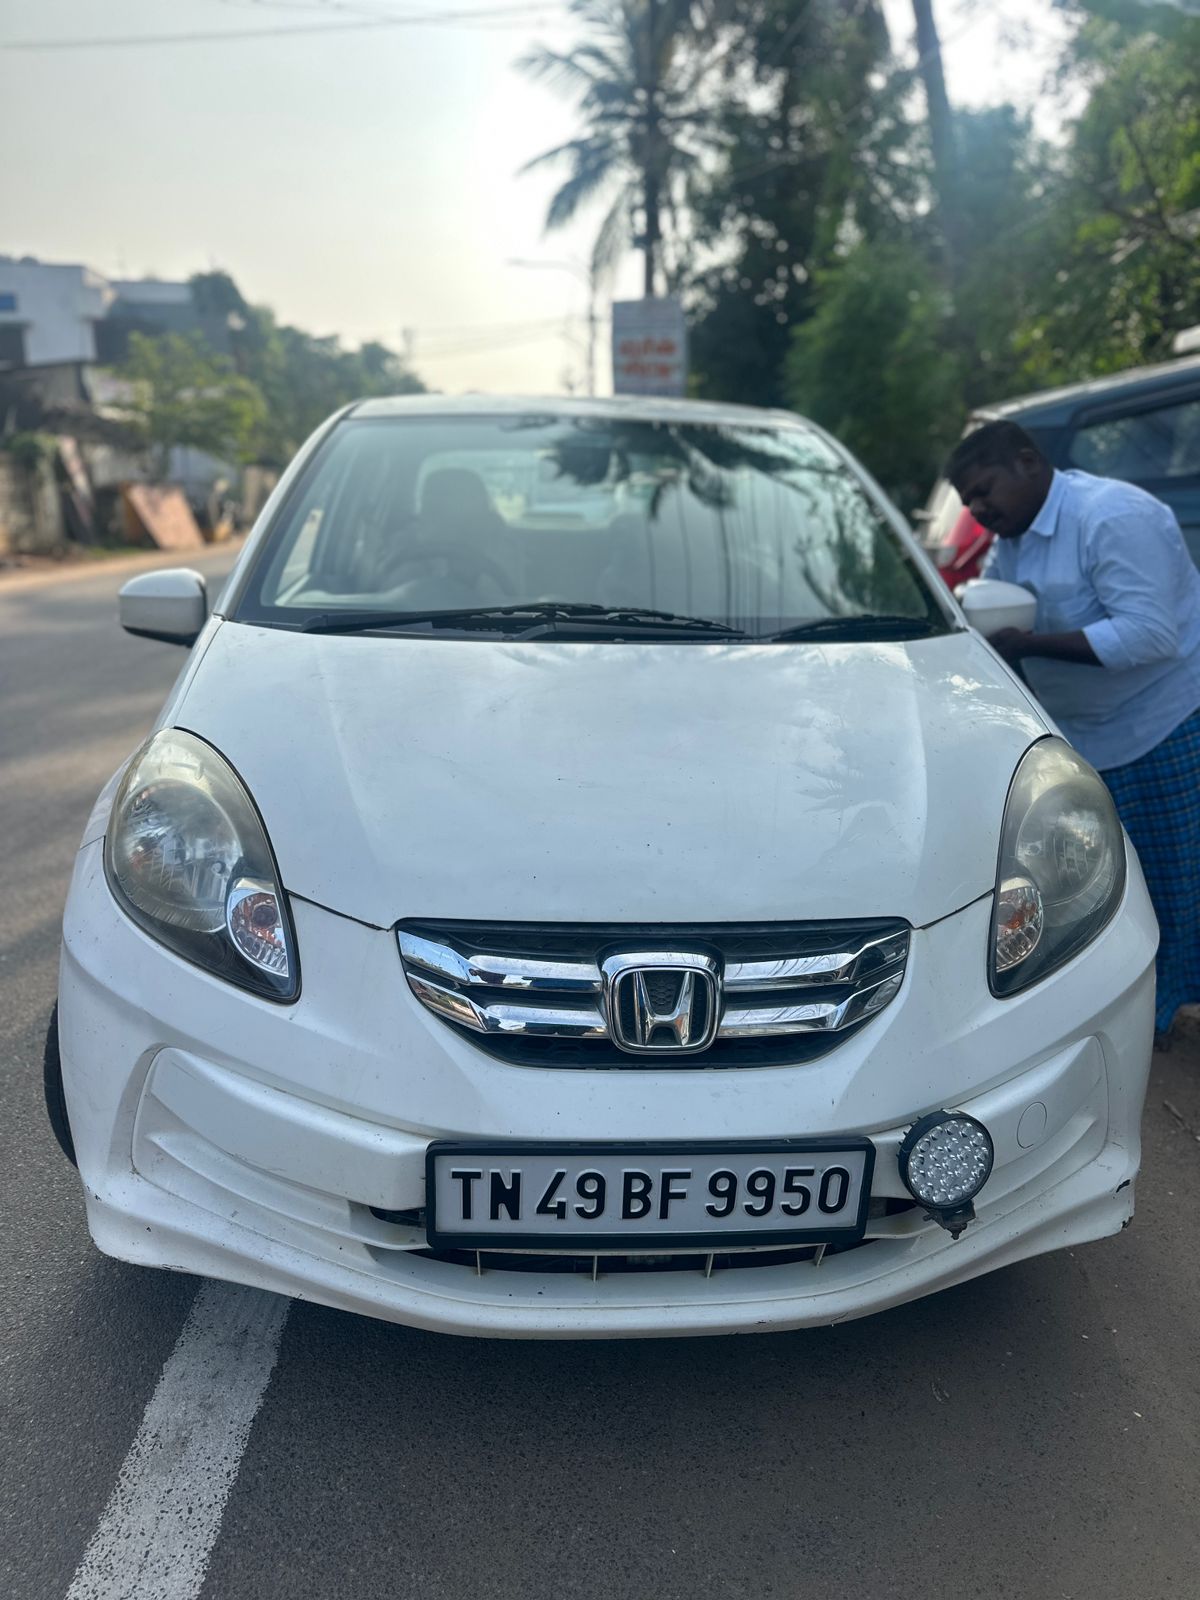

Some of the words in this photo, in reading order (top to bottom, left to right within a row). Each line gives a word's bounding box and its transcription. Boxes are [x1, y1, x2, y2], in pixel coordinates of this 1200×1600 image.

[450, 1169, 522, 1221] TN
[535, 1169, 607, 1221] 49
[621, 1169, 692, 1221] BF
[705, 1166, 851, 1219] 9950
